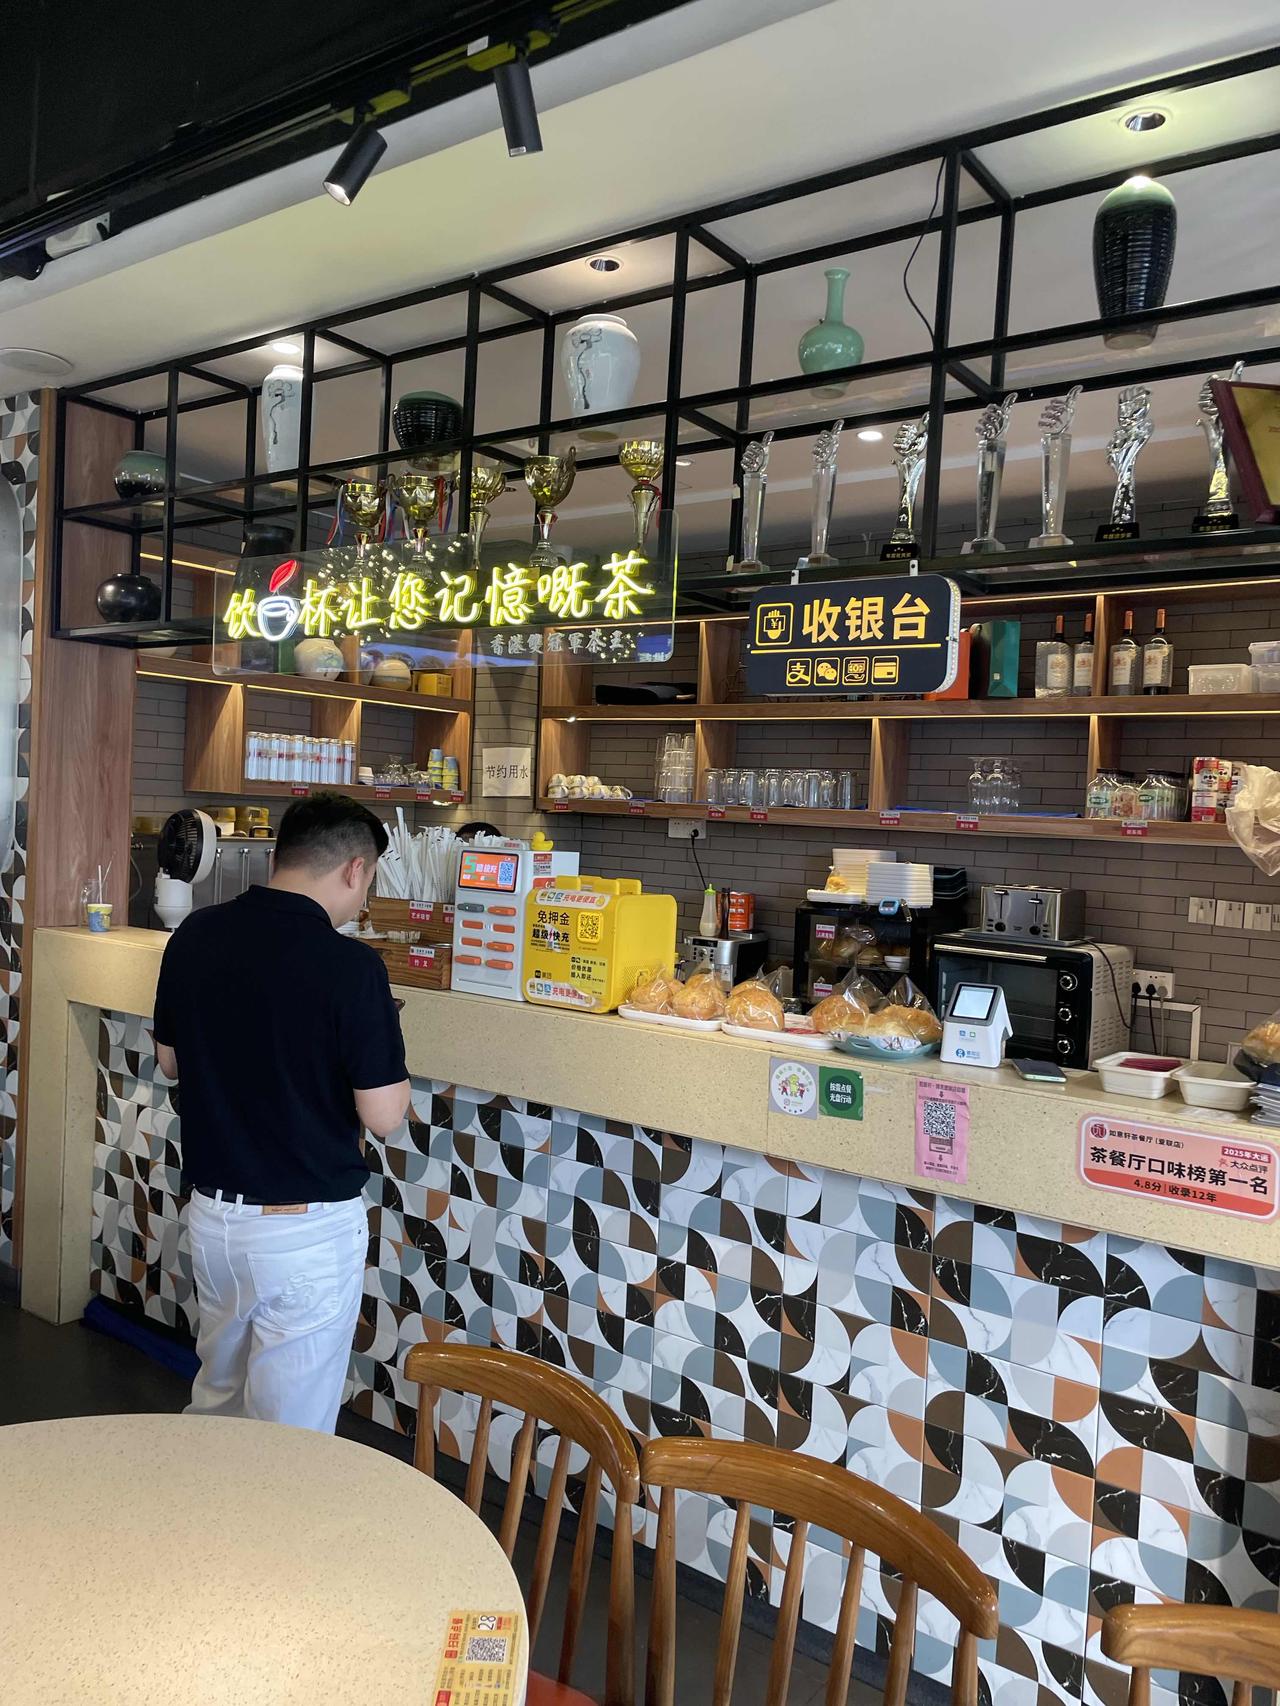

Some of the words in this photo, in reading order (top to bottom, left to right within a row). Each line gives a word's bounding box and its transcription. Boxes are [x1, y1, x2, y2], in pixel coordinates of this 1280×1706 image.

[802, 592, 931, 643] 收银台
[485, 765, 528, 779] 节约用水
[537, 910, 570, 926] 免押金
[830, 1082, 851, 1094] 按需点餐
[830, 1093, 852, 1104] 光盘行动
[1090, 1146, 1268, 1195] 茶餐厅口味榜第一名
[1230, 1160, 1268, 1174] 大众点评
[478, 1615, 497, 1631] 28
